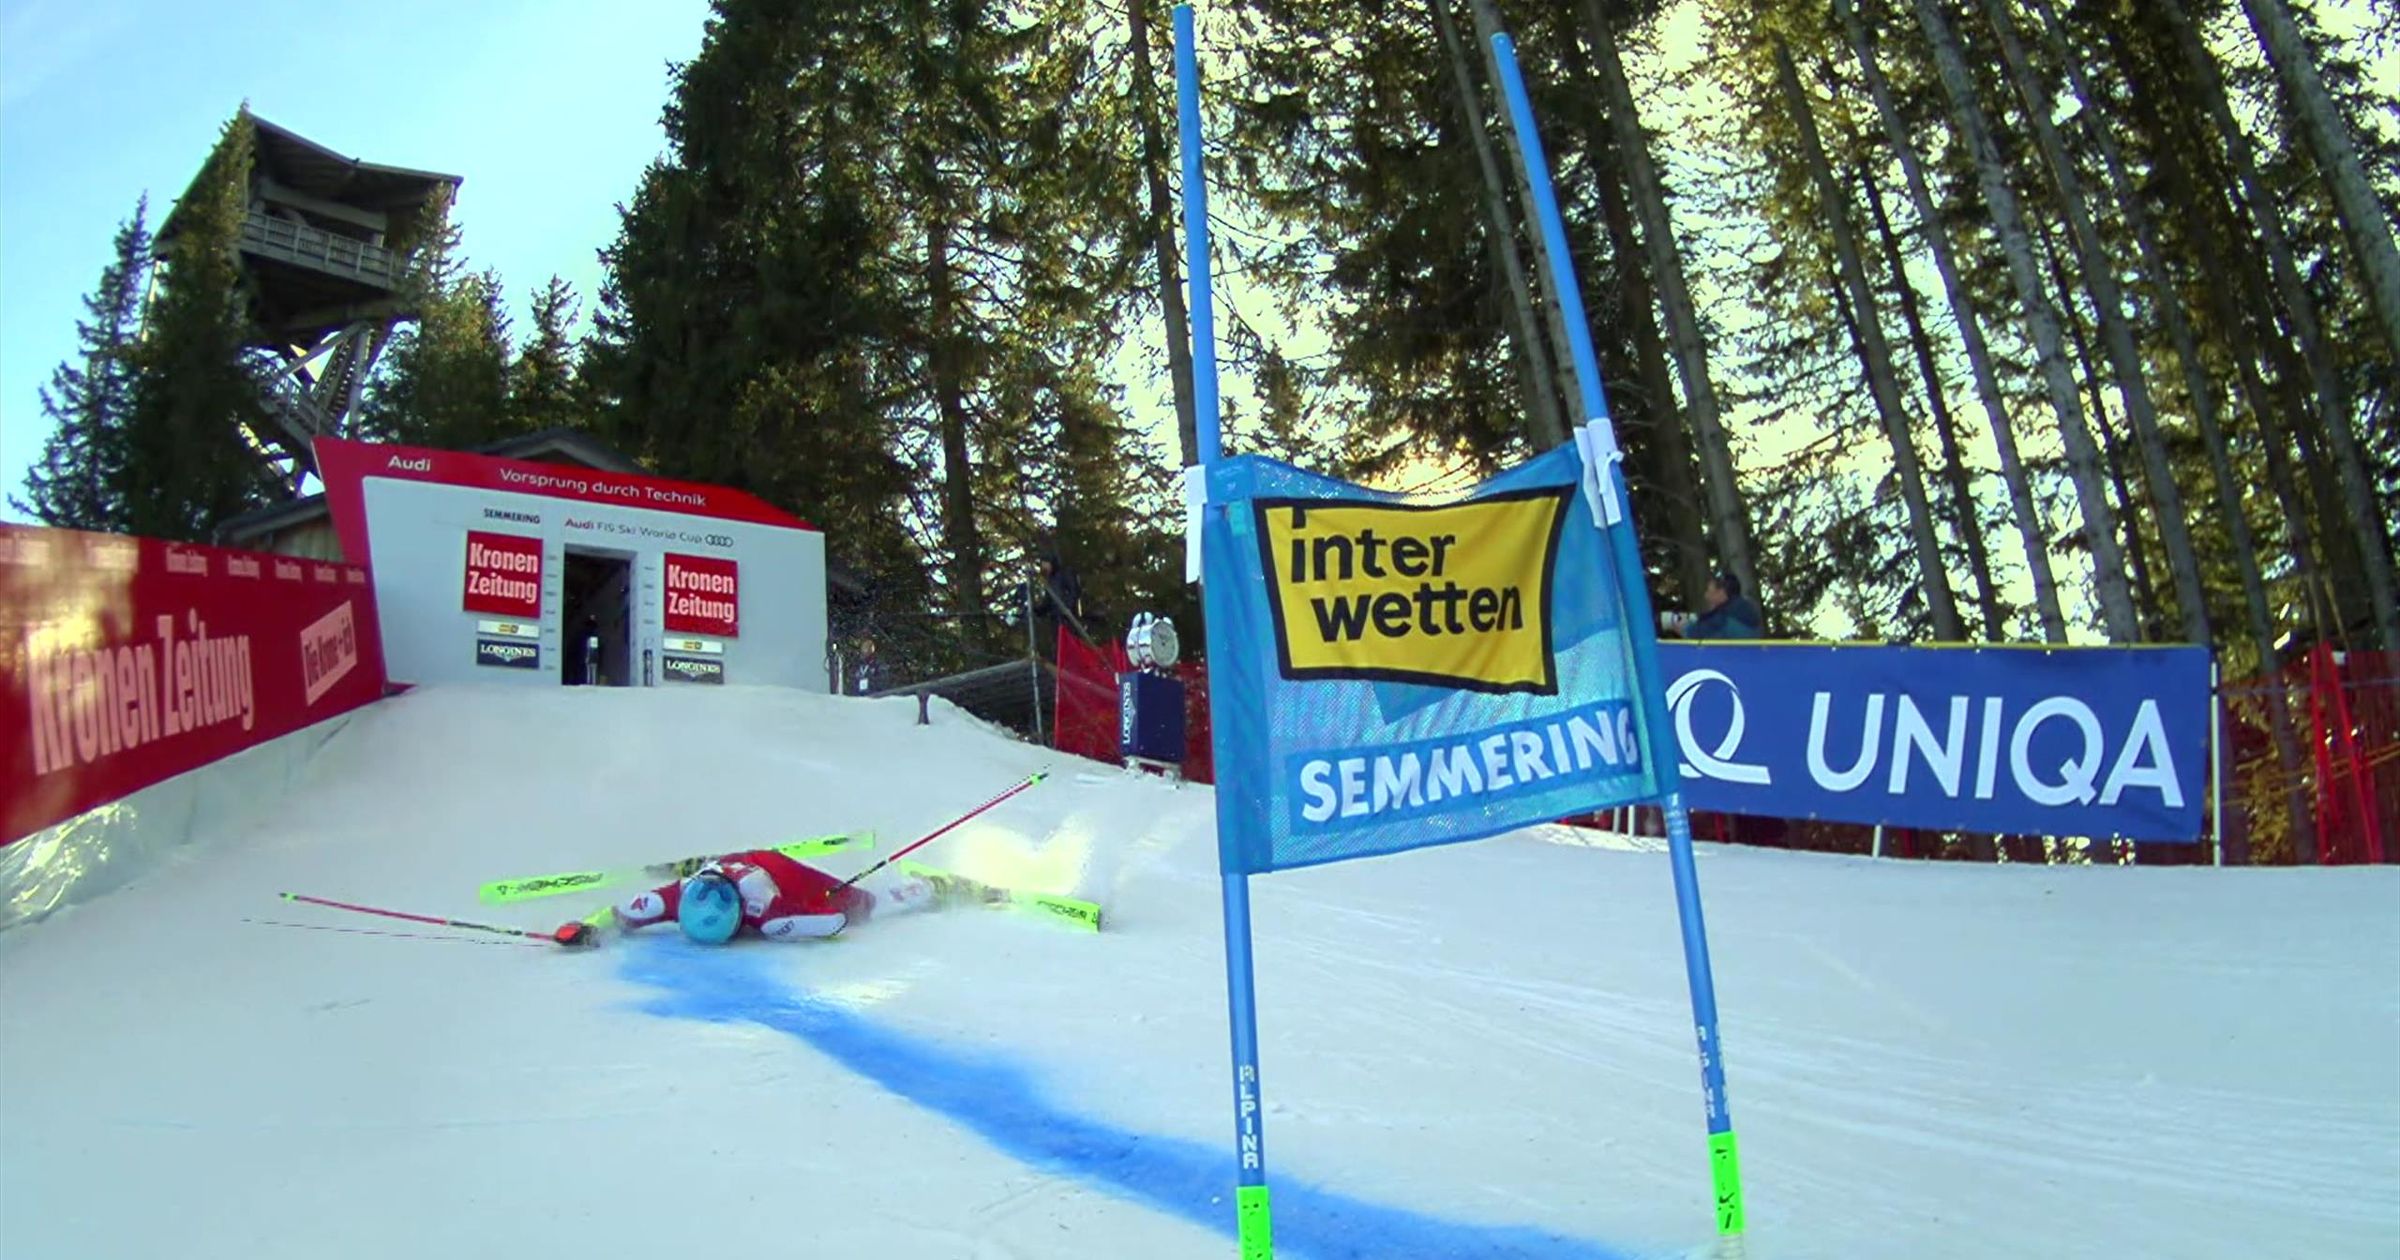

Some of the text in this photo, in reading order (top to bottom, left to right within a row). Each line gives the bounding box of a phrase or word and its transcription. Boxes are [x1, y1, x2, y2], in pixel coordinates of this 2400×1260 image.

[387, 455, 431, 472] Audi
[499, 467, 707, 506] Vorsprung durch Technik
[484, 508, 541, 524] SEMMERING
[564, 518, 594, 530] Audi
[470, 543, 538, 574] Kronen
[1290, 507, 1456, 583] inter
[468, 571, 537, 604] Zeitung
[668, 564, 734, 594] Kronen
[668, 592, 735, 623] Zeitung
[1310, 582, 1523, 643] wetten
[480, 644, 536, 658] LONGINES
[666, 660, 721, 674] LONGINES
[26, 607, 255, 776] Kronen Zeitung
[1300, 708, 1639, 822] SEMMERING
[1806, 691, 2185, 808] UNIQA
[1239, 1064, 1259, 1170] ALPINA
